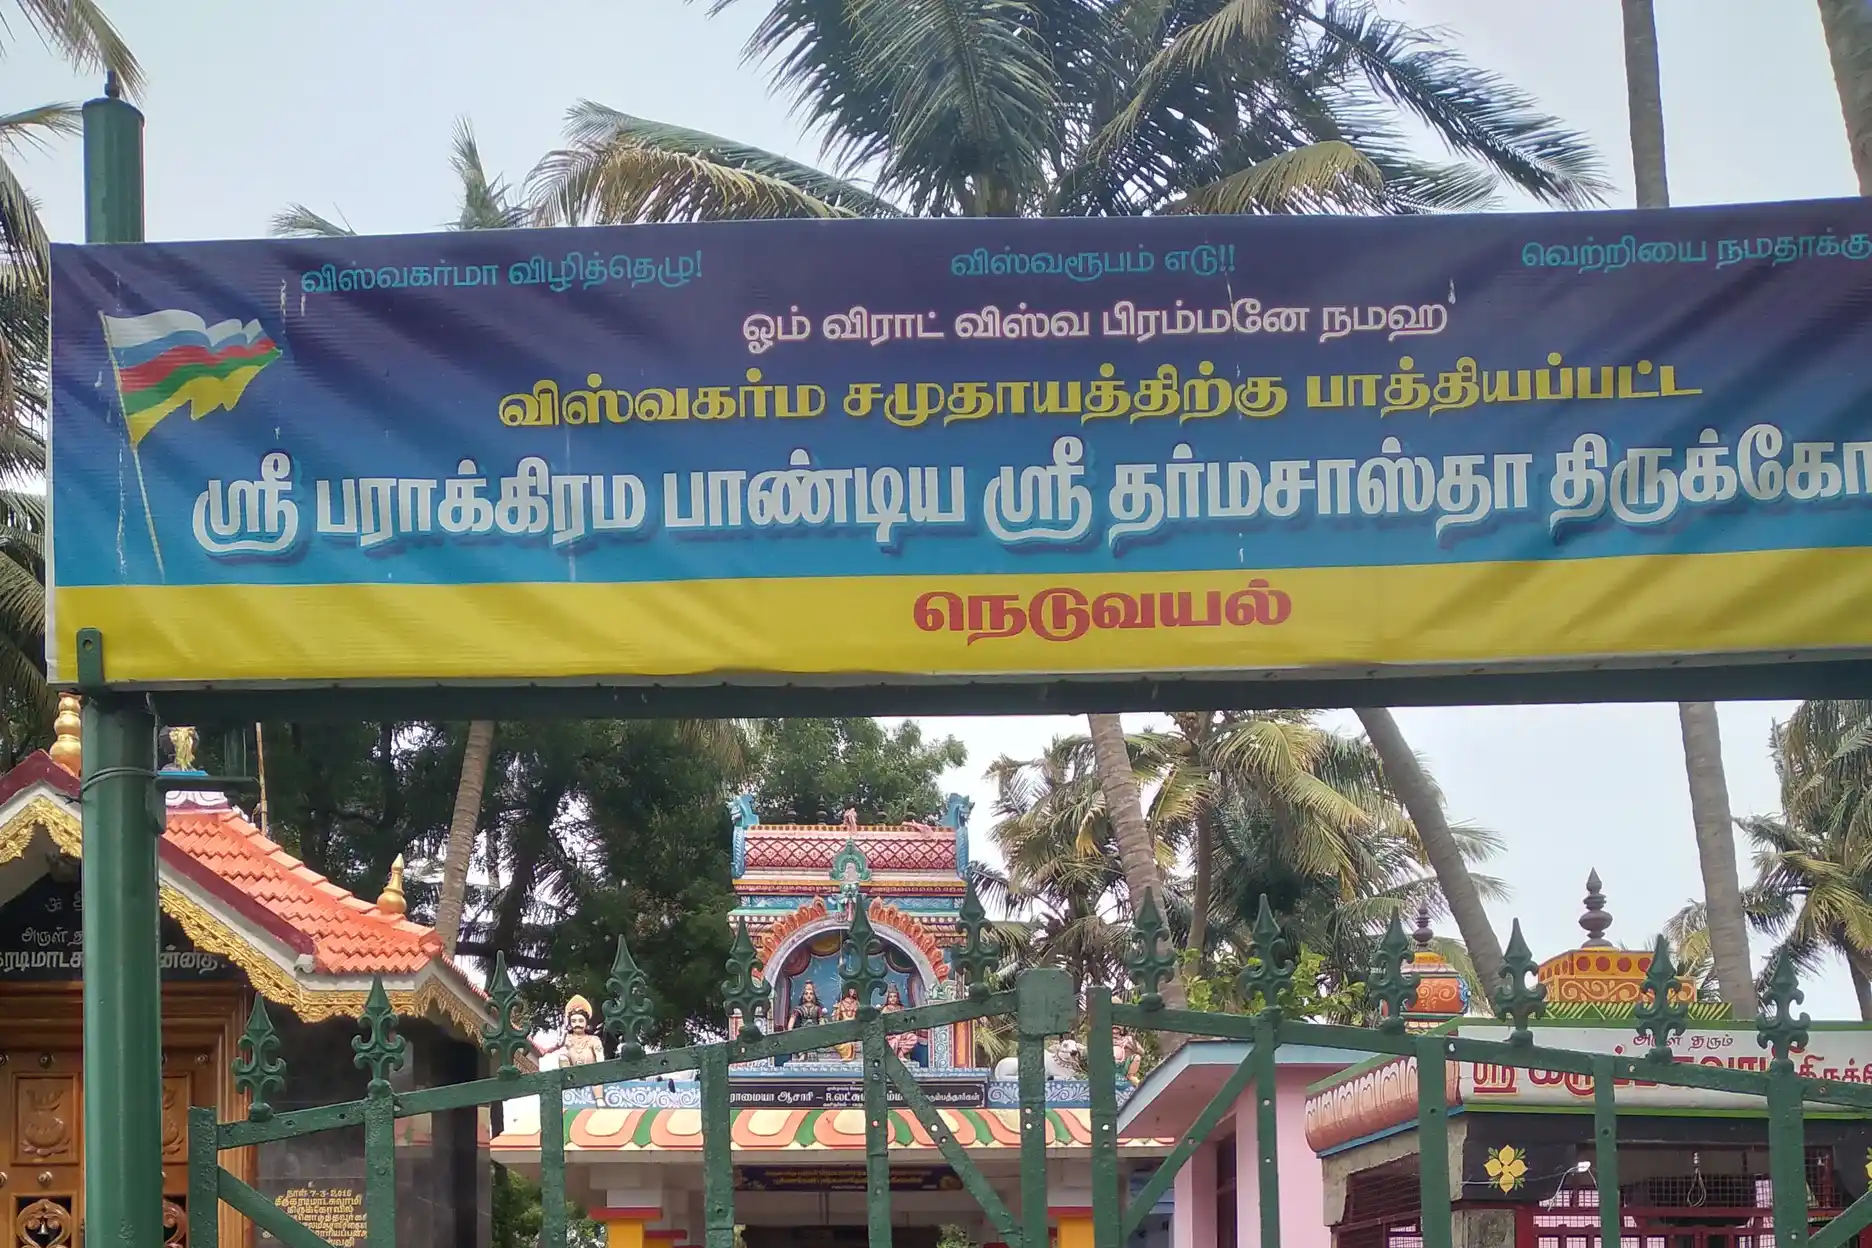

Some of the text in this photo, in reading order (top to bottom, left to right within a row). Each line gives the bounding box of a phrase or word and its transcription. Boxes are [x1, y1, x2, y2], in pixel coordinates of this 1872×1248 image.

[300, 250, 702, 293] விஸ்வகர்மா விழித்தெழு!
[951, 243, 1155, 282] விஸ்வரூபம்
[1521, 234, 1707, 274] வெற்றியை
[743, 297, 1448, 355] ஓம் விராட் விஸ்வ பிரம்மனே நமஹ
[498, 351, 1703, 428] விஸ்வகர்ம சமுதாயத்திற்கு பாத்தியப்பட்ட
[315, 456, 646, 548] பராக்கிரம
[663, 447, 966, 544] பாண்டிய
[1108, 436, 1533, 548] தர்மசாஸ்தா
[912, 578, 1292, 647] நெடுவயல்
